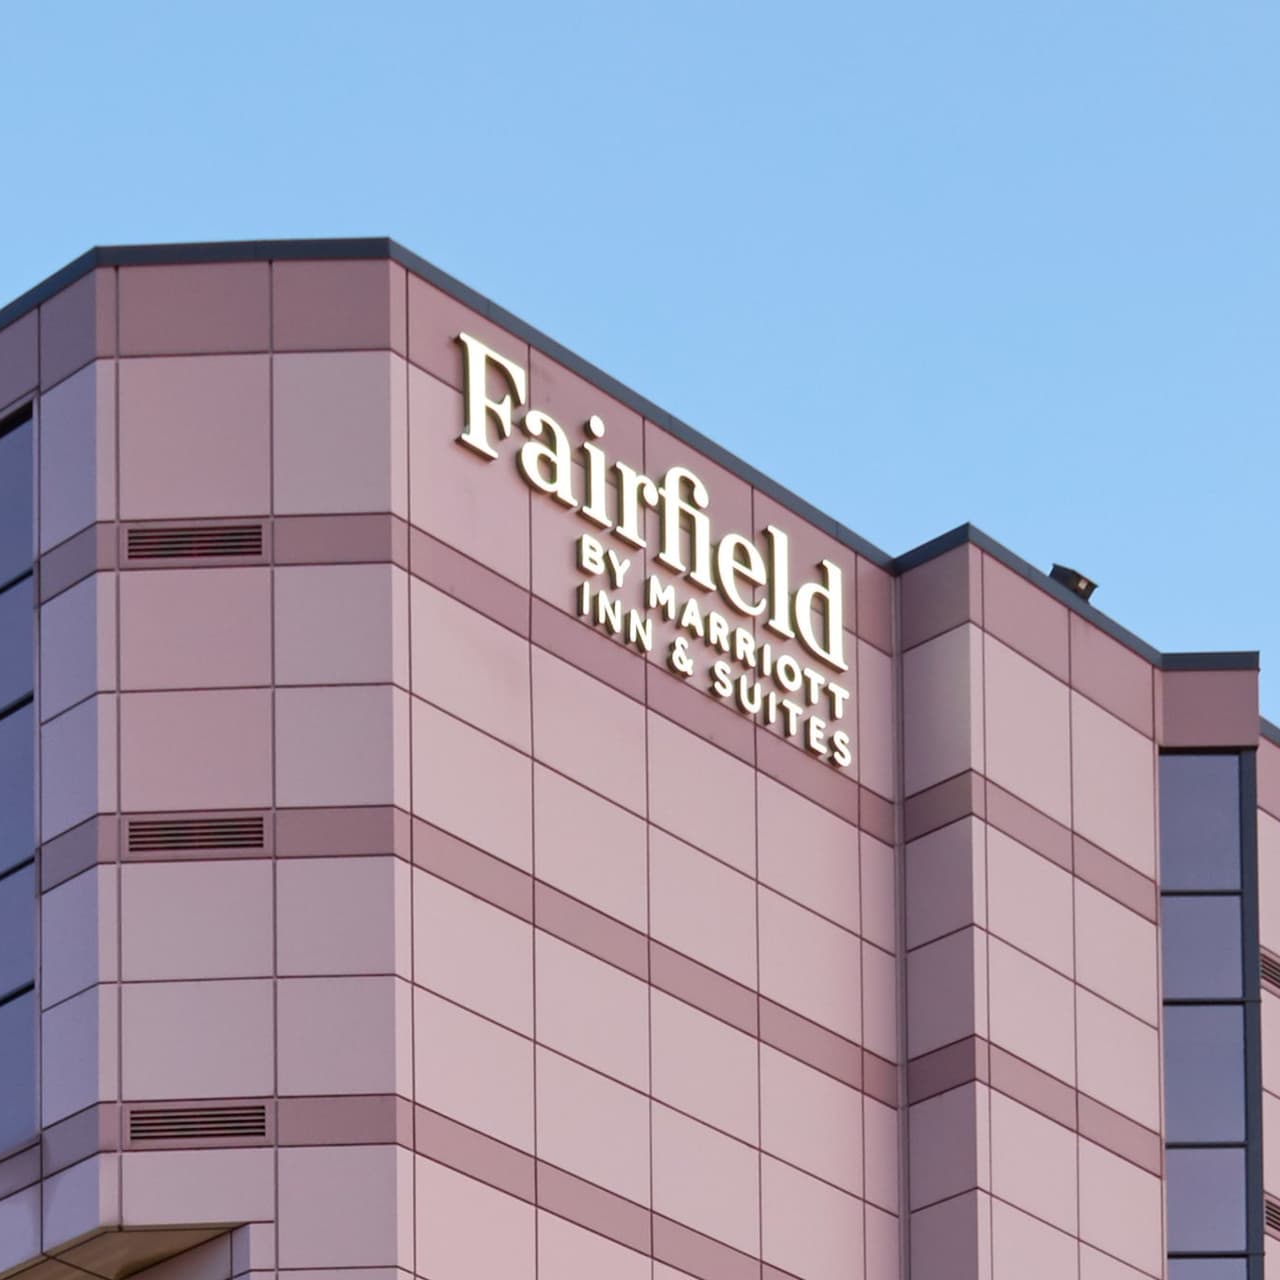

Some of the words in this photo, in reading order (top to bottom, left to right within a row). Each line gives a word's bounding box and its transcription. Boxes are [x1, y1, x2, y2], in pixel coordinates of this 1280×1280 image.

[455, 332, 849, 672] Fairfield
[576, 533, 631, 588] BY
[646, 574, 850, 721] MARRIOTT
[577, 581, 653, 653] INN
[669, 636, 694, 678] &
[710, 660, 852, 768] SUITES
